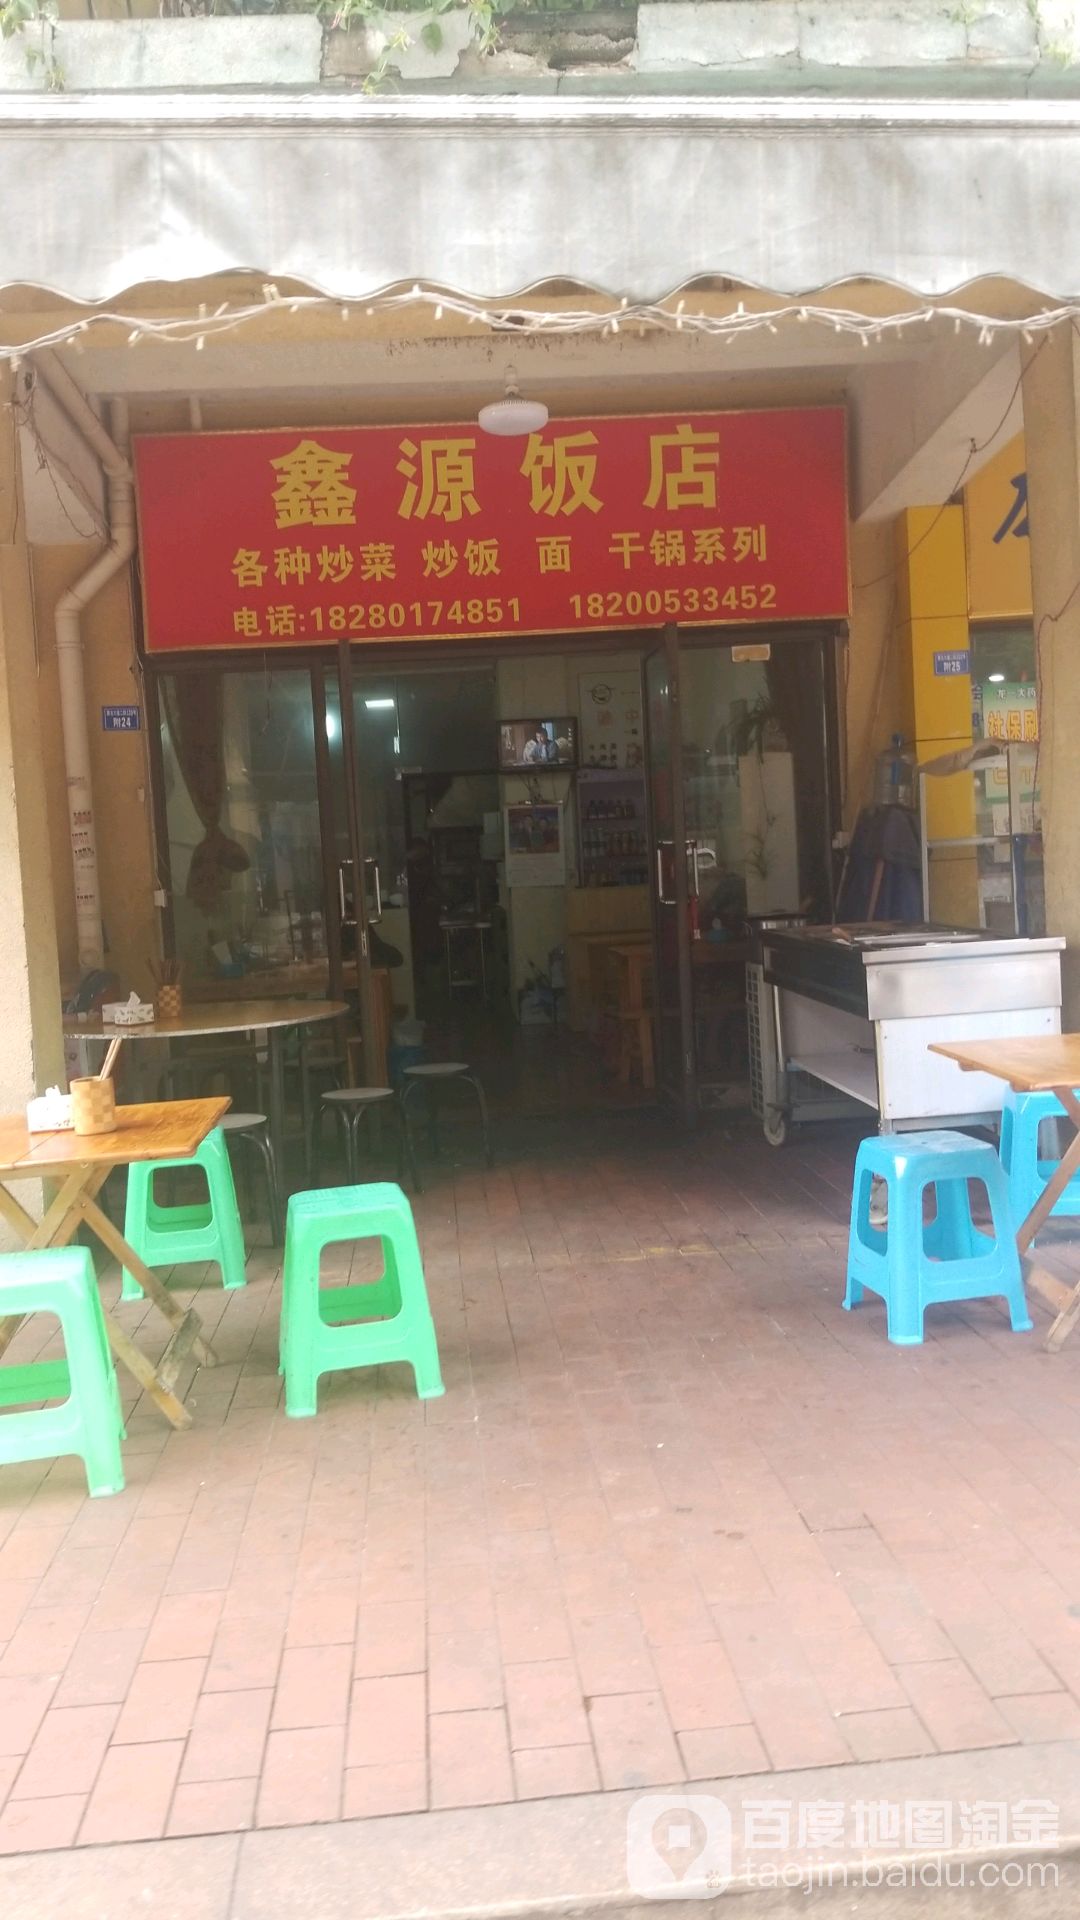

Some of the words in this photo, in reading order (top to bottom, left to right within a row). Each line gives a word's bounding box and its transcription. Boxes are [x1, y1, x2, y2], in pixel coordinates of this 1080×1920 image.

[270, 424, 720, 528] 鑫源饭店
[232, 543, 395, 587] 各种炒菜
[421, 539, 501, 578] 炒饭
[536, 537, 571, 573] 面
[608, 525, 768, 569] 干锅系列
[233, 599, 522, 636] 电话:18280174851
[570, 586, 776, 621] 18200533452
[113, 717, 131, 728] 附24
